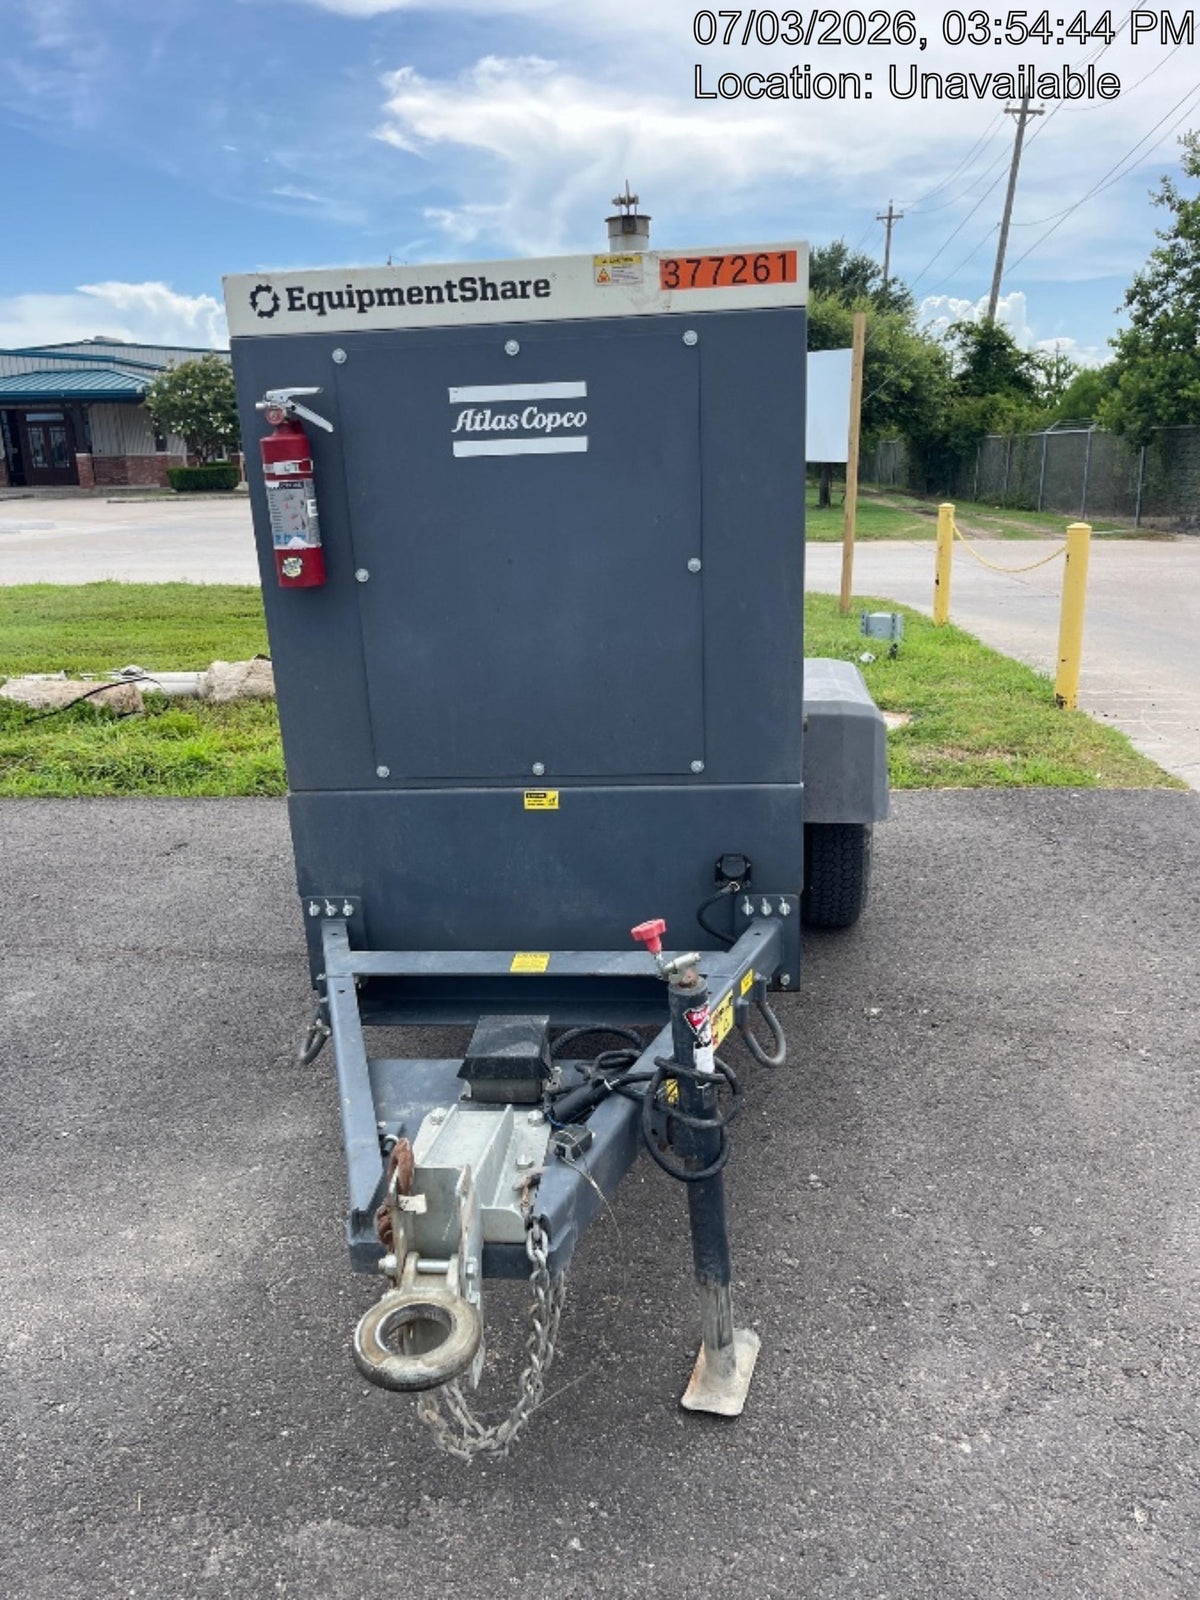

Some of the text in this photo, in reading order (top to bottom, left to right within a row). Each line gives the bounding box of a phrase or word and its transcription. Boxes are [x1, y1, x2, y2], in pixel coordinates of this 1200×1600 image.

[663, 253, 787, 289] 377261
[286, 277, 551, 316] EquipmentShare
[451, 406, 588, 433] Atlas Copco
